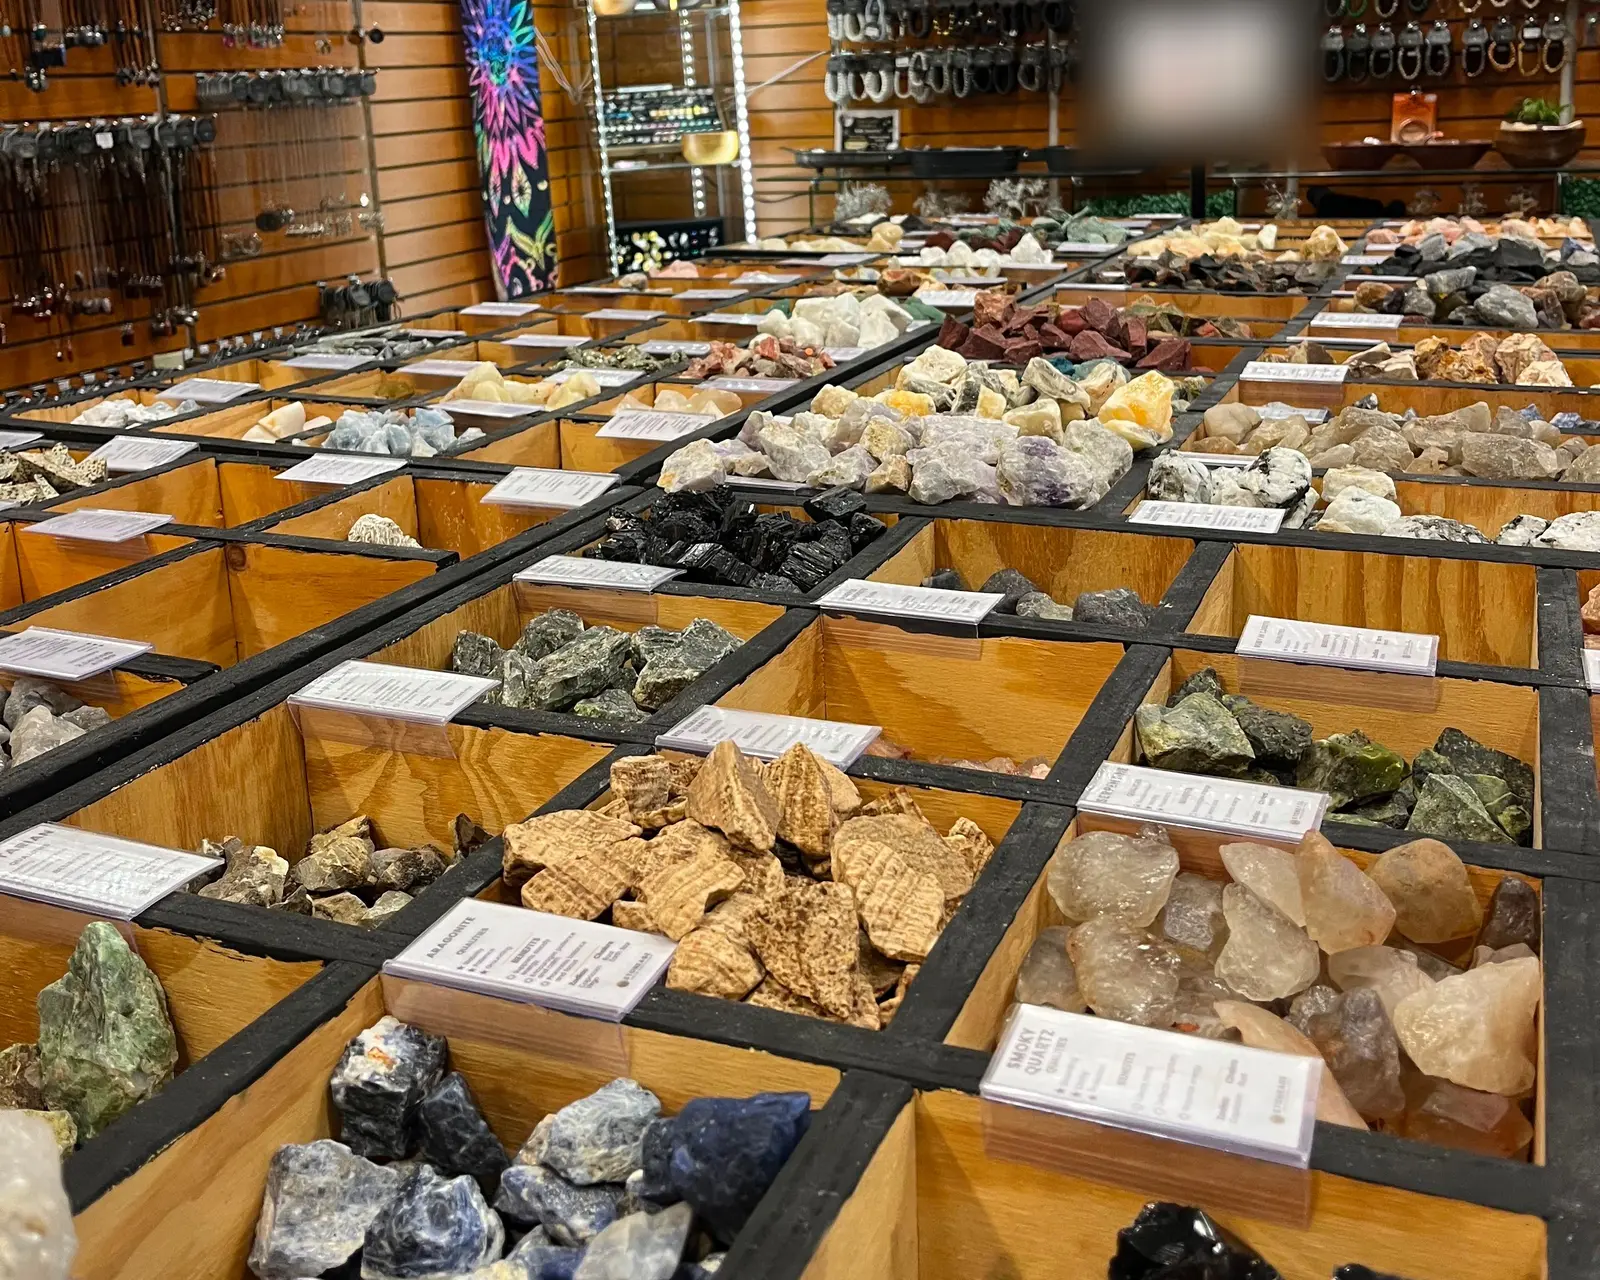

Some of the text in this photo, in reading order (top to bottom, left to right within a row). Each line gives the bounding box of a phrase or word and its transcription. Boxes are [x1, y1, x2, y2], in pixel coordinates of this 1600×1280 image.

[426, 917, 476, 959] ARAGONITE
[456, 928, 489, 955] QUALITIES
[510, 938, 541, 964] BENEFITS
[1006, 1027, 1036, 1069] SMOKY
[1024, 1029, 1056, 1075] QUARTZ
